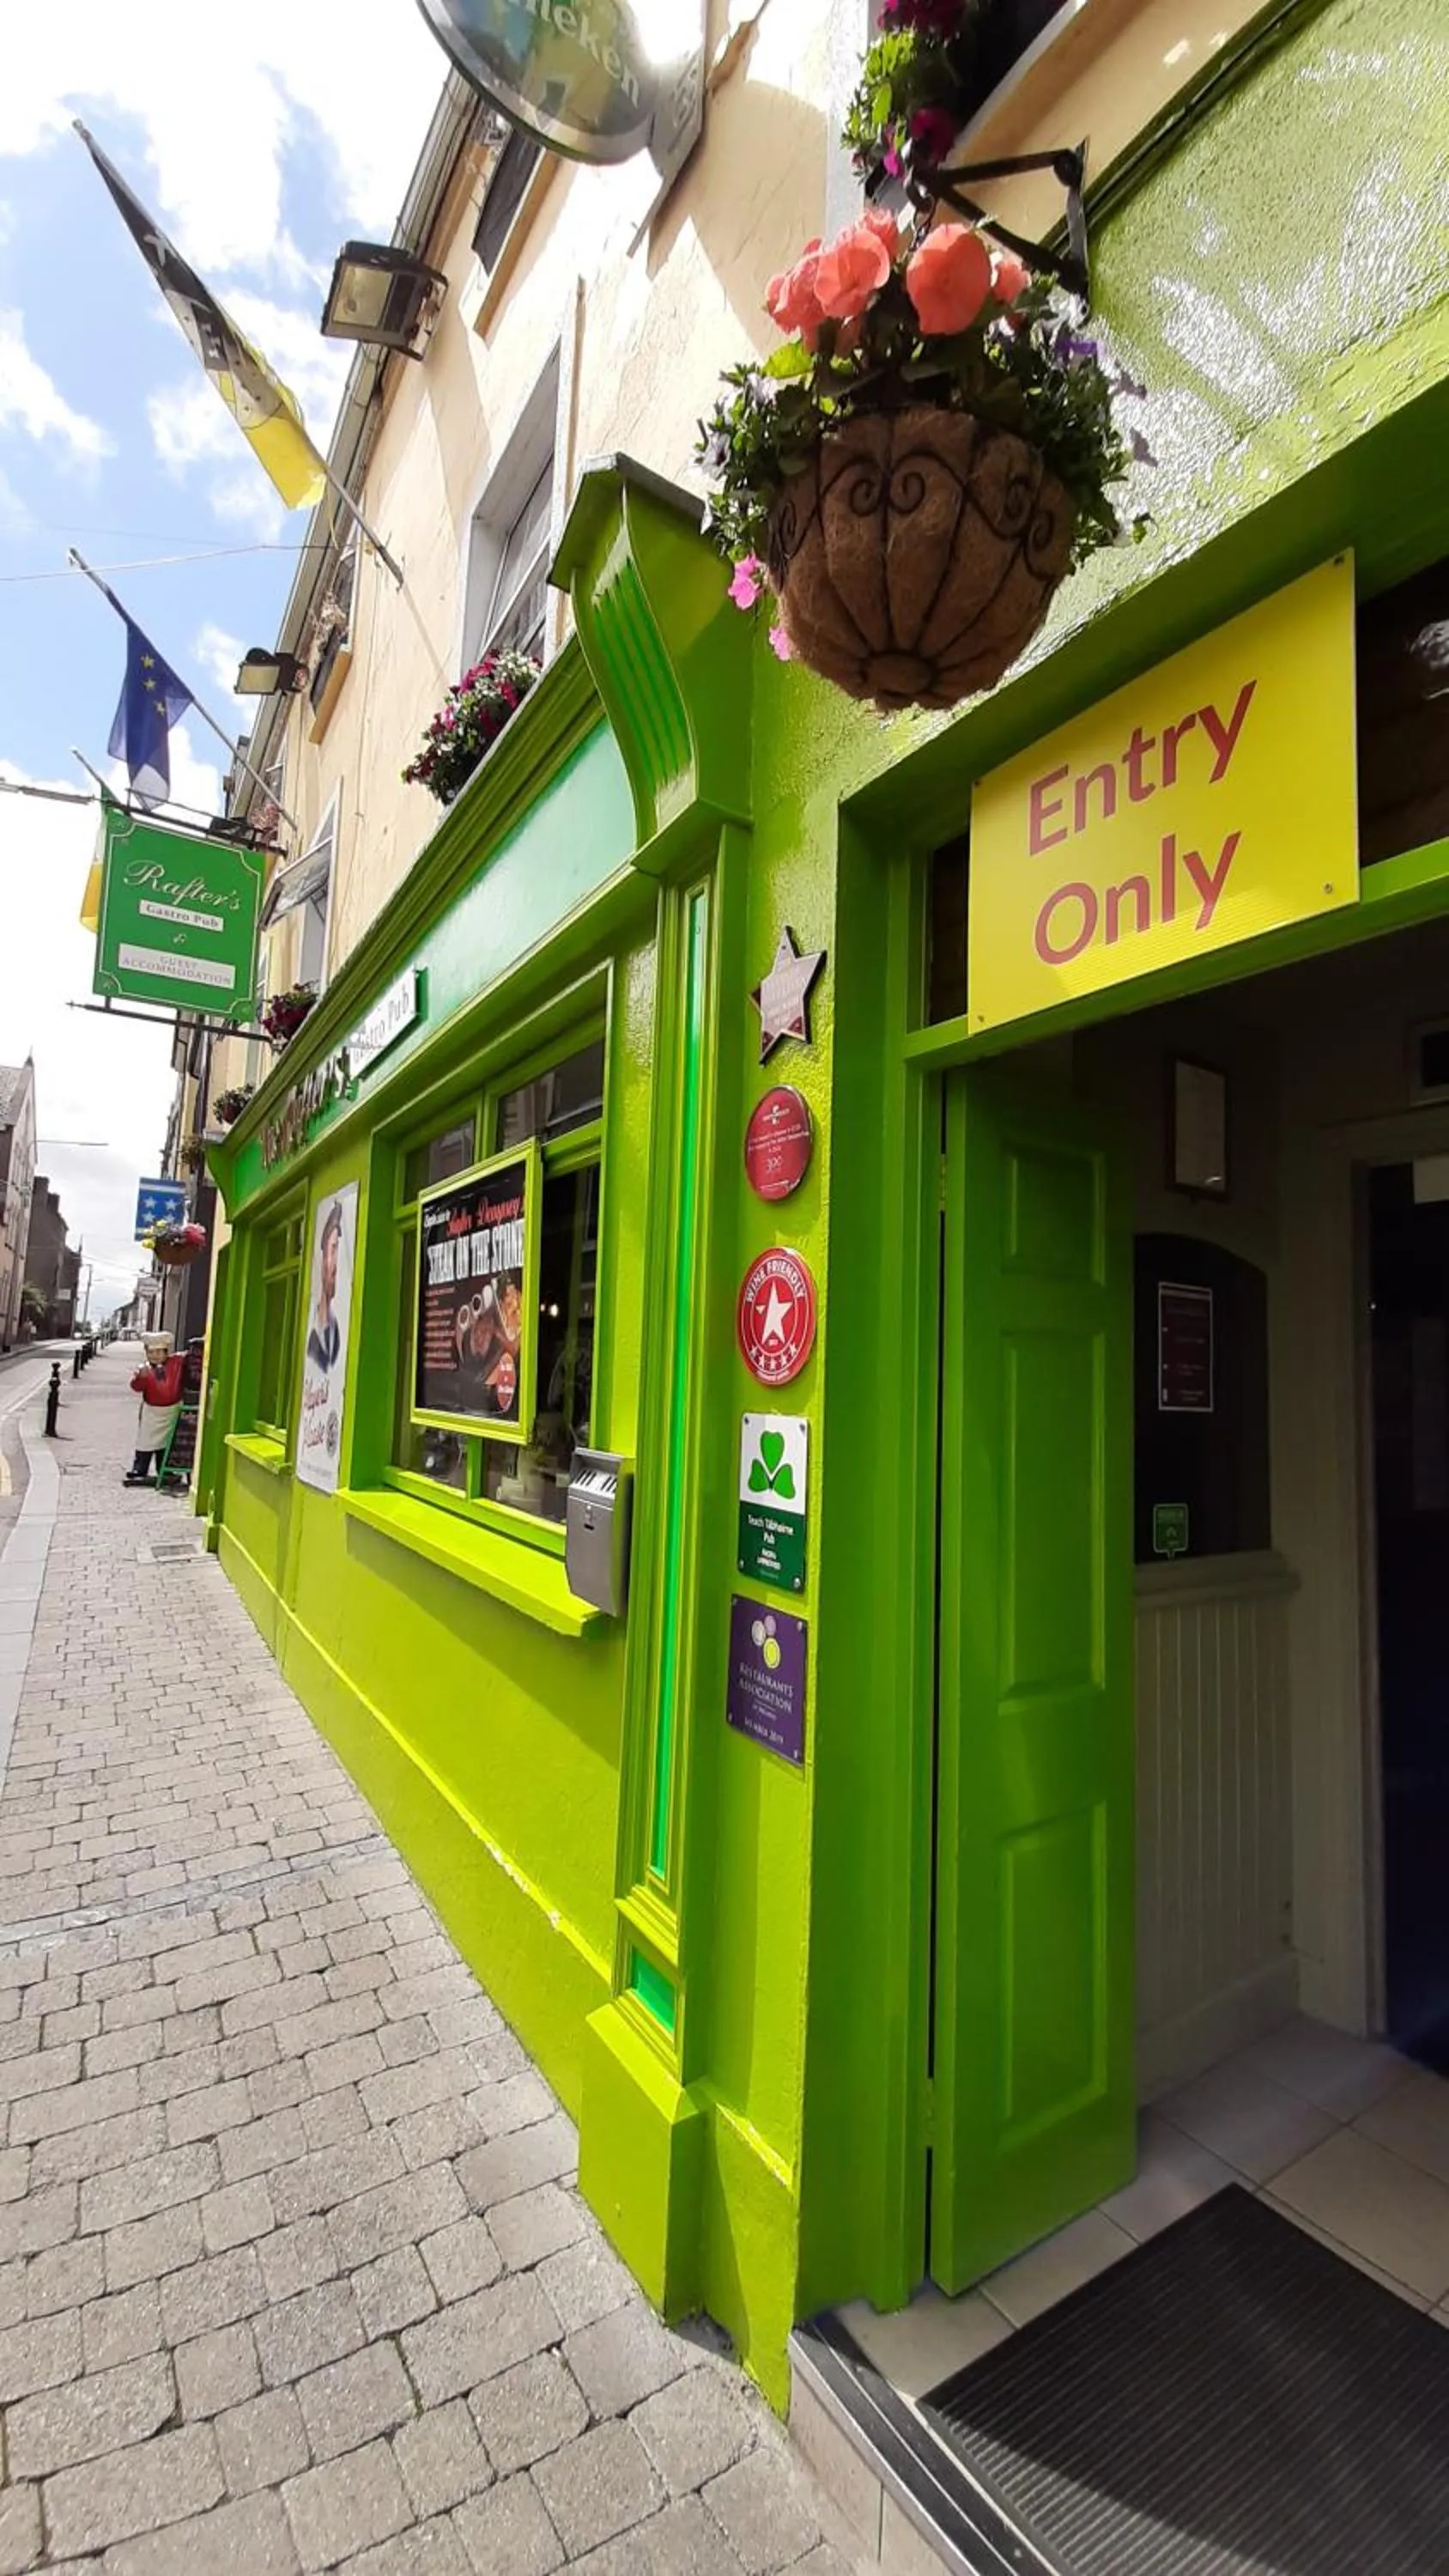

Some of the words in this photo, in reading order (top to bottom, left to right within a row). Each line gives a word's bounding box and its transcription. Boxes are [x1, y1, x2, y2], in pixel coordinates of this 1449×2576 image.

[1028, 679, 1258, 857] Entry
[123, 860, 239, 910] Rafter's
[1034, 829, 1242, 967] Only
[146, 903, 190, 921] Gastro
[193, 914, 220, 928] Pub
[122, 956, 232, 986] ACCOMMODATION
[159, 955, 199, 969] GUEST
[387, 983, 410, 1032] Pub
[456, 1235, 470, 1281] ON
[470, 1229, 490, 1277] THE
[745, 1268, 766, 1303] WINE
[767, 1259, 806, 1298] FRIENDLY
